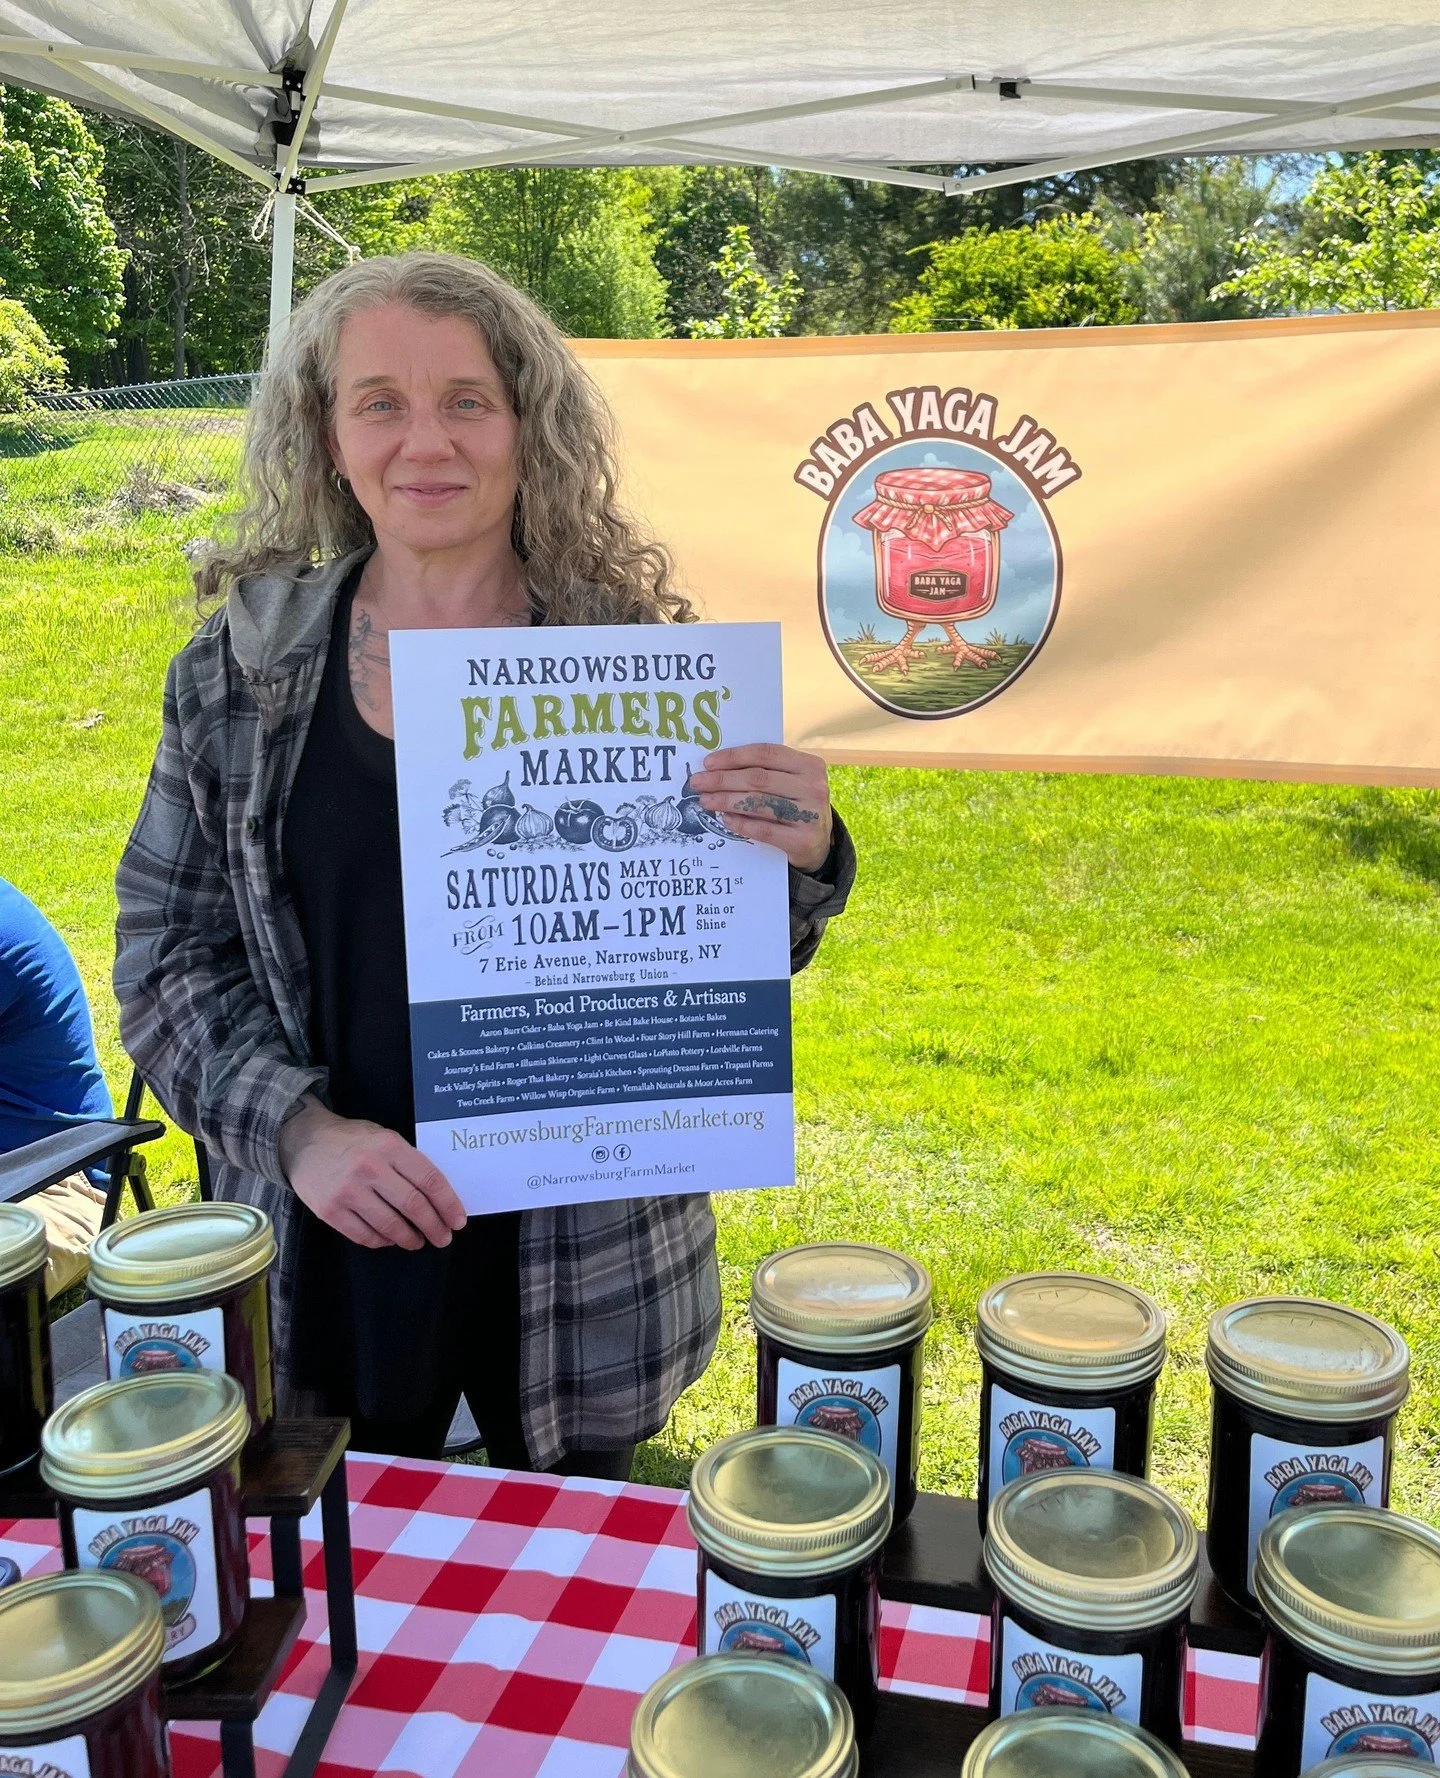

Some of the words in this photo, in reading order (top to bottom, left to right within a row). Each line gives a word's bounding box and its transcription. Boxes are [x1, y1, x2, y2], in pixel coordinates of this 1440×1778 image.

[797, 405, 889, 497] BABA
[888, 388, 995, 440] YAGA
[997, 418, 1079, 496] JAM
[914, 576, 936, 586] BABA
[940, 576, 962, 586] YAGA
[929, 586, 946, 596] JAM
[466, 653, 716, 685] NARROWSBURG
[460, 686, 733, 760] FARMERS'
[520, 745, 676, 786] MARKET
[619, 860, 662, 878] MAY
[669, 857, 704, 876] 16th
[447, 861, 611, 910] SATURDAYS
[620, 877, 706, 899] OCTOBER
[711, 876, 744, 895] 31st
[695, 904, 720, 916] Rain
[723, 906, 735, 915] or
[696, 918, 726, 930] Shine
[452, 922, 505, 947] FROM
[479, 958, 489, 973] 7
[495, 956, 528, 972] Erie
[533, 952, 592, 970] Avenue,
[596, 949, 693, 966] Narrowsburg,
[698, 944, 722, 959] NY
[534, 974, 569, 987] Behind
[573, 971, 635, 984] Narrowsburg
[640, 968, 669, 980] Union
[460, 1004, 530, 1023] Farmers,
[535, 996, 576, 1016] Food
[580, 993, 659, 1013] Producers
[663, 989, 678, 1007] &
[681, 988, 747, 1007] Artisans
[479, 1029, 502, 1038] Aaron
[503, 1027, 520, 1036] Burr
[521, 1025, 541, 1034] Cider
[548, 1023, 565, 1032] Baba
[584, 1021, 599, 1030] Jam
[604, 1019, 614, 1028] Be
[615, 1017, 632, 1027] Kind
[633, 1016, 650, 1025] Bake
[651, 1016, 674, 1025] House
[680, 1014, 705, 1023] Botanic
[706, 1012, 727, 1021] Bakes
[427, 1050, 450, 1060] Cakes
[451, 1049, 459, 1057] &
[460, 1048, 484, 1057] Scones
[485, 1044, 510, 1054] Bakery
[546, 1040, 580, 1049] Creamery
[586, 1036, 604, 1046] Clint
[605, 1036, 613, 1044] In
[614, 1034, 635, 1044] Wood
[641, 1033, 657, 1042] Four
[658, 1032, 676, 1042] Story
[678, 1030, 691, 1040] Hill
[692, 1030, 710, 1039] Farm
[716, 1028, 748, 1038] Hermana
[749, 1026, 779, 1036] Catering
[480, 1062, 494, 1072] End
[496, 1061, 515, 1070] Farm
[548, 1056, 578, 1066] Skincare
[584, 1054, 602, 1064] Light
[602, 1052, 628, 1061] Curves
[628, 1050, 648, 1060] Glass
[680, 1046, 705, 1056] Pottery
[710, 1044, 740, 1054] Lordville
[742, 1044, 763, 1052] Farms
[434, 1084, 452, 1093] Rock
[453, 1081, 476, 1092] Valley
[476, 1079, 502, 1090] Spirits
[506, 1077, 528, 1087] Roger
[528, 1074, 544, 1083] That
[546, 1073, 570, 1082] Bakery
[605, 1067, 632, 1077] Kitchen
[637, 1064, 672, 1076] Sprouting
[673, 1064, 700, 1073] Dreams
[701, 1062, 719, 1071] Farm
[752, 1060, 774, 1068] Farms
[457, 1098, 473, 1108] Two
[474, 1096, 496, 1106] Creek
[496, 1095, 516, 1104] Farm
[520, 1091, 546, 1101] Willow
[548, 1089, 567, 1100] Wisp
[568, 1088, 596, 1098] Organic
[596, 1086, 616, 1095] Farm
[656, 1080, 686, 1090] Naturals
[686, 1080, 694, 1088] &
[694, 1078, 714, 1088] Moor
[714, 1078, 734, 1086] Acres
[734, 1076, 753, 1086] Farm
[451, 1108, 765, 1151] NarrowsburgFarmersMarket.org
[527, 1163, 695, 1190] @NarrowsburgFarmMarket
[140, 1323, 179, 1340] YAGA
[179, 1329, 211, 1357] JAM
[790, 1381, 822, 1410] BABA
[822, 1379, 862, 1397] YAGA
[862, 1387, 888, 1415] JAM
[1000, 1411, 1030, 1440] BABA
[1029, 1410, 1071, 1434] YAGA
[1071, 1427, 1101, 1457] JAM
[1264, 1457, 1306, 1491] BABA
[1305, 1454, 1349, 1473] YAGA
[1348, 1462, 1373, 1490] JAM
[168, 1517, 199, 1545] JAM
[745, 1601, 788, 1628] YAGA
[788, 1617, 821, 1650] JAM
[1046, 1653, 1093, 1683] YAGA
[1092, 1675, 1126, 1710] JAM
[1320, 1704, 1370, 1738] BABA
[1368, 1703, 1417, 1726] YAGA
[0, 1755, 33, 1775] AGA
